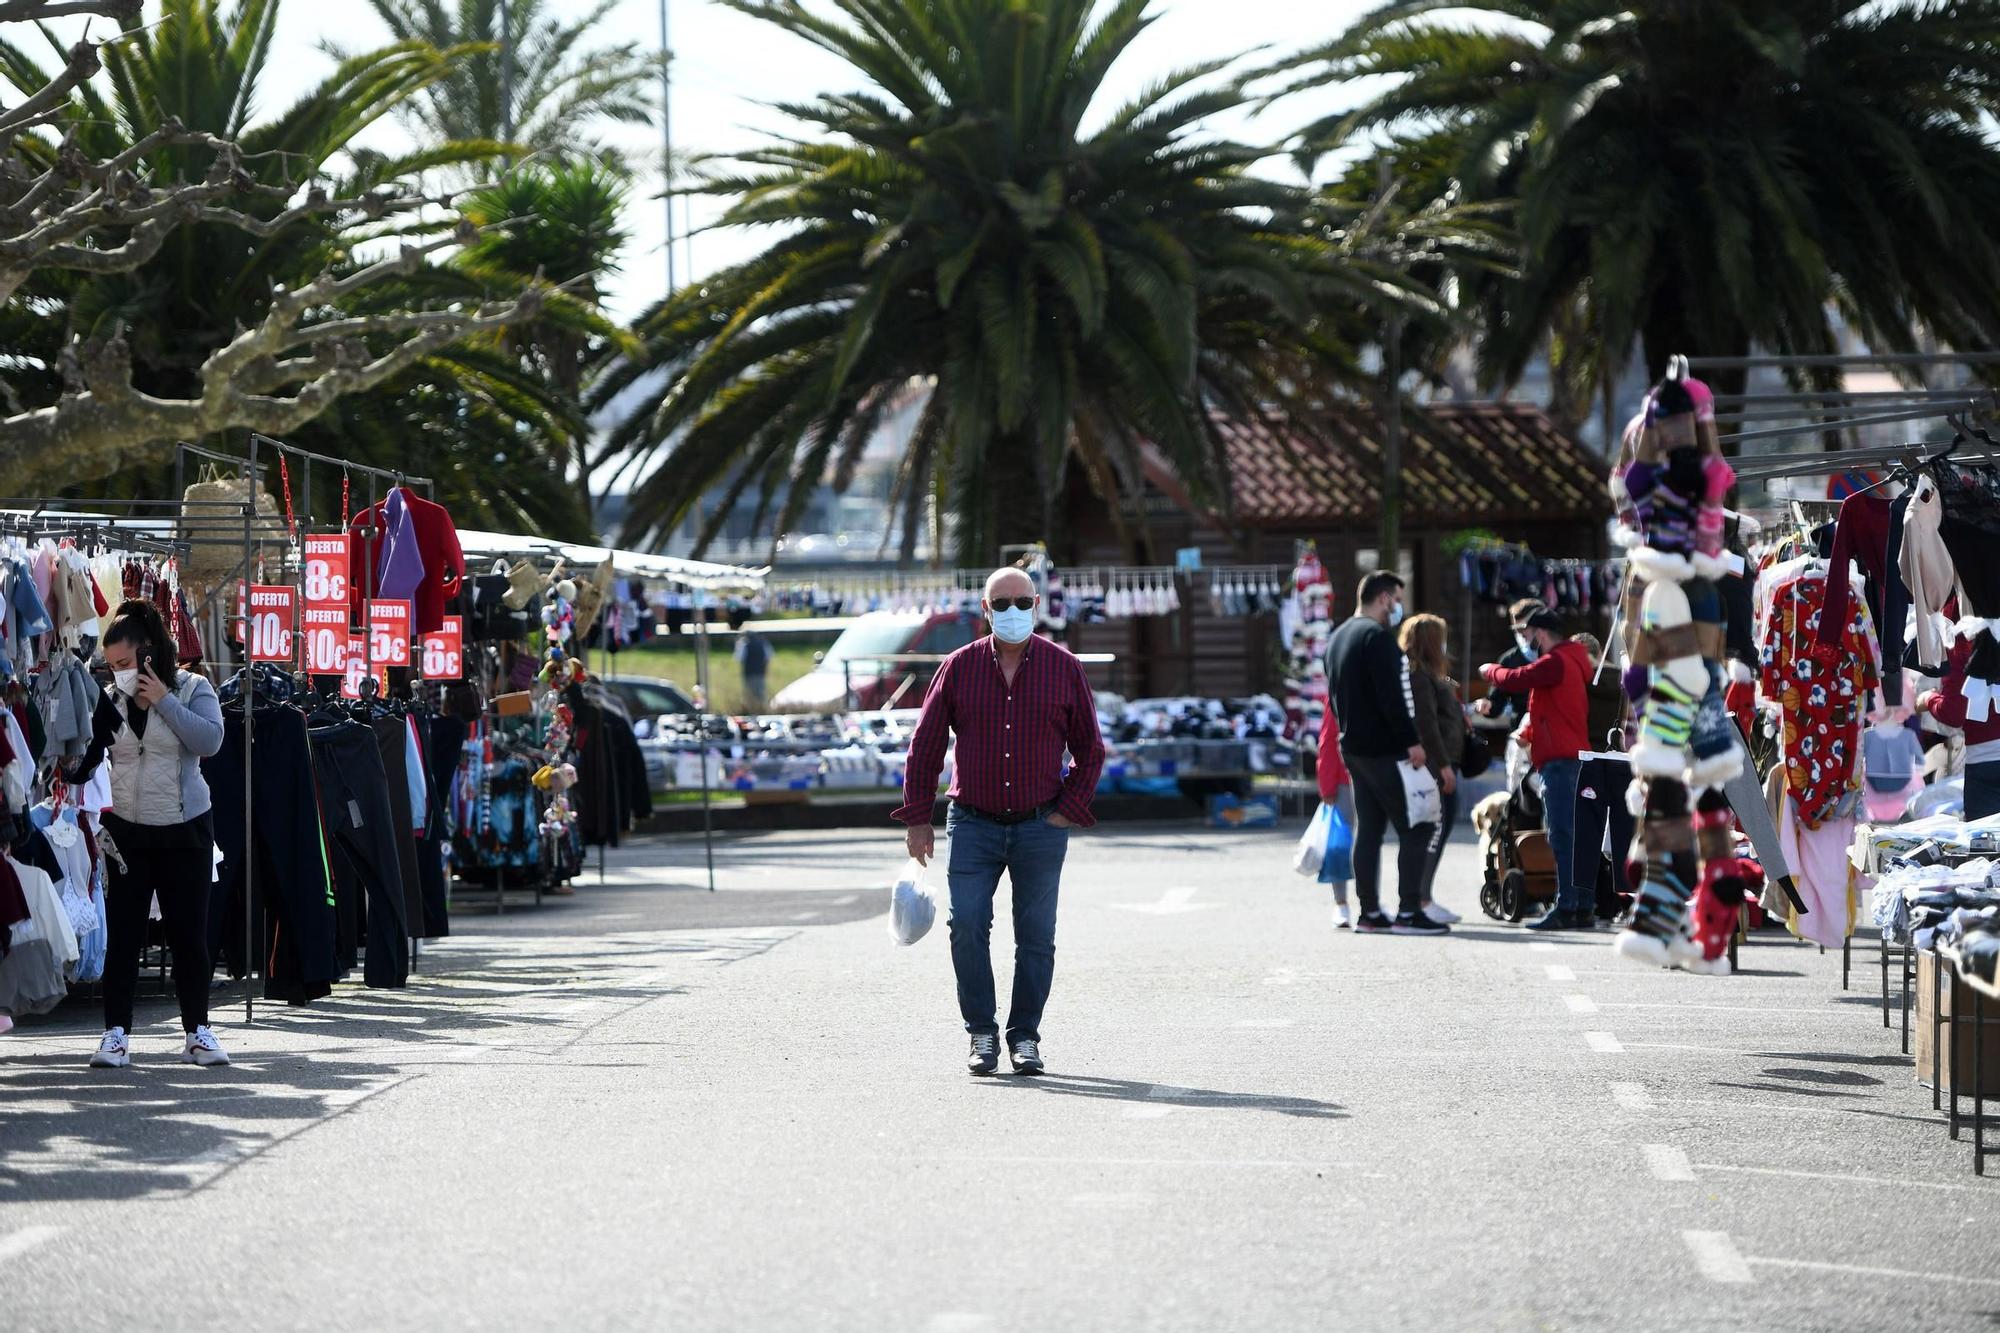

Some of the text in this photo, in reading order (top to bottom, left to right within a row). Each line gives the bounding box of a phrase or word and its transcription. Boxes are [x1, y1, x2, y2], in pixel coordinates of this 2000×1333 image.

[305, 541, 345, 554] OFERTA
[251, 592, 290, 606] OFERTA
[305, 559, 346, 601] 8€
[251, 612, 291, 657] 10€
[305, 609, 345, 623] OFERTA
[307, 628, 347, 670] 10€
[370, 623, 406, 662] 5€
[423, 638, 459, 676] 6€
